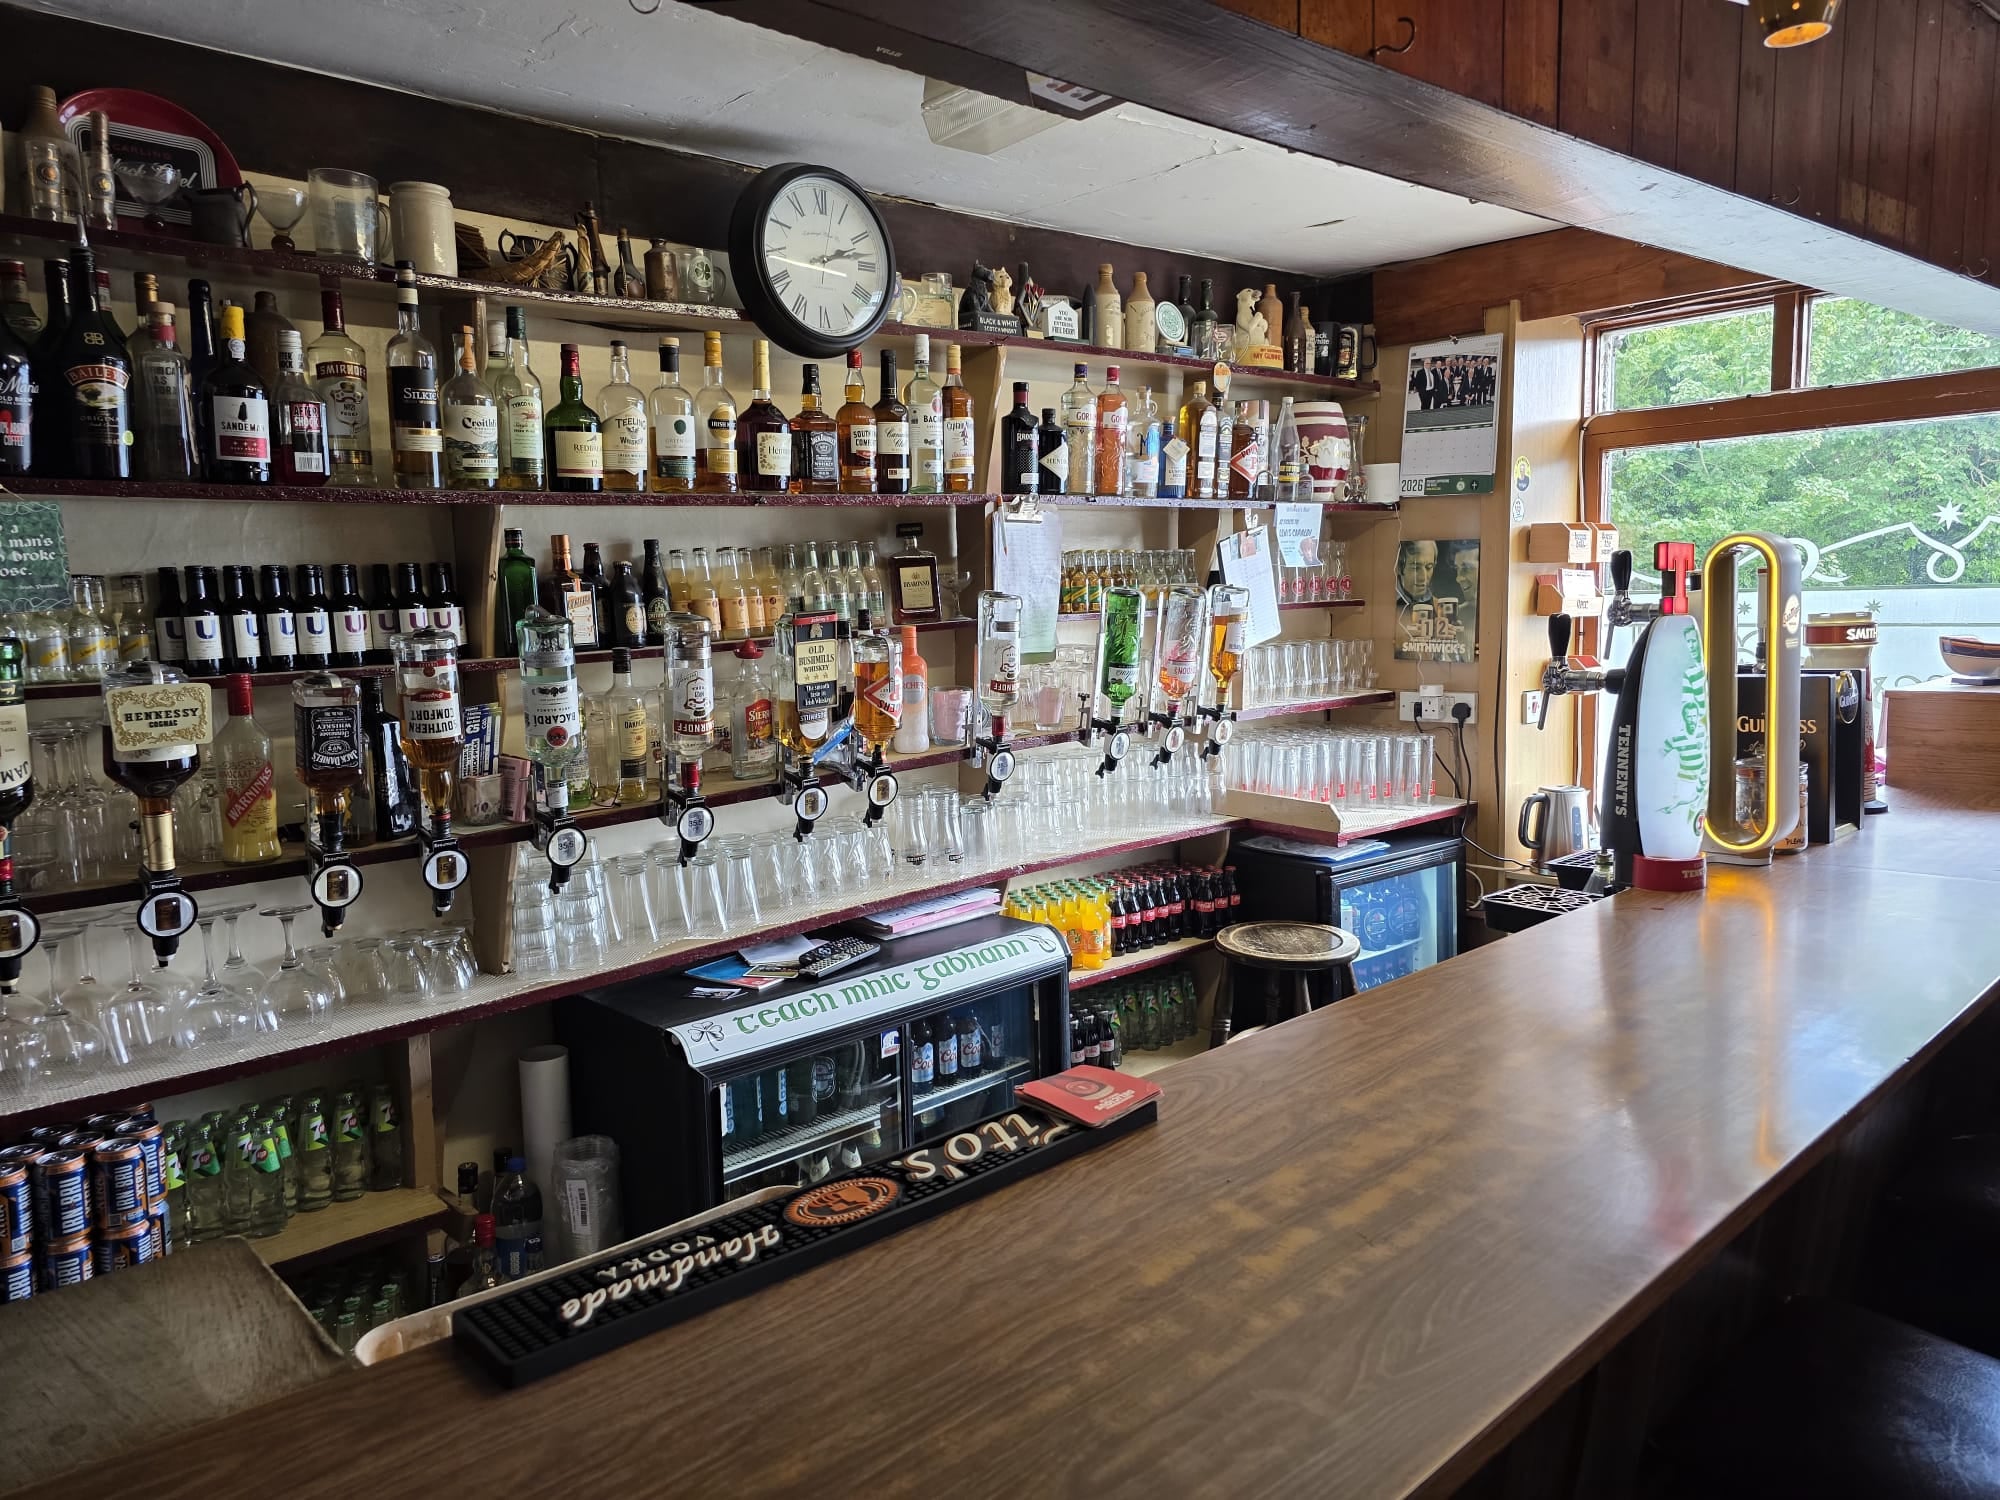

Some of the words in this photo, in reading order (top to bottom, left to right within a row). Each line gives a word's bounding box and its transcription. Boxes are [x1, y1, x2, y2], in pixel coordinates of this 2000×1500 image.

[786, 191, 805, 222] XI
[813, 188, 827, 216] XII
[838, 203, 849, 225] I
[770, 211, 792, 238] X
[851, 231, 870, 245] II
[858, 260, 876, 272] III
[770, 269, 792, 296] VIII
[791, 294, 808, 321] VII
[843, 303, 855, 325] V
[819, 305, 831, 329] VI
[980, 316, 996, 325] BLACK
[1002, 319, 1019, 328] WHITE
[984, 325, 1000, 333] SCOTCH
[319, 363, 367, 377] SMIRNOFF
[293, 405, 320, 416] AFTER
[221, 421, 265, 432] SANDEMAN
[294, 416, 320, 428] SHOCK
[619, 436, 644, 446] WHISKEY
[590, 459, 599, 468] 12
[1401, 479, 1423, 492] 2026
[9, 533, 54, 548] man's
[12, 550, 57, 562] broke
[1424, 620, 1431, 637] 1
[1437, 620, 1446, 636] 2
[808, 645, 825, 655] OLD
[1402, 641, 1466, 655] SMITHWICK'S
[798, 653, 835, 666] BUSHMILLS
[803, 664, 830, 673] WHISKEY
[124, 707, 200, 723] HENNESSY
[148, 719, 179, 728] COGNAC
[316, 723, 352, 731] WHISKEY
[1737, 715, 1817, 734] GUISS
[311, 751, 341, 766] DANIEL'S
[339, 749, 359, 765] JACK
[1615, 724, 1631, 817] TENNENT'S
[227, 765, 273, 822] WARNINKS
[595, 1234, 717, 1279] VODKA
[560, 1223, 781, 1327] Handmade
